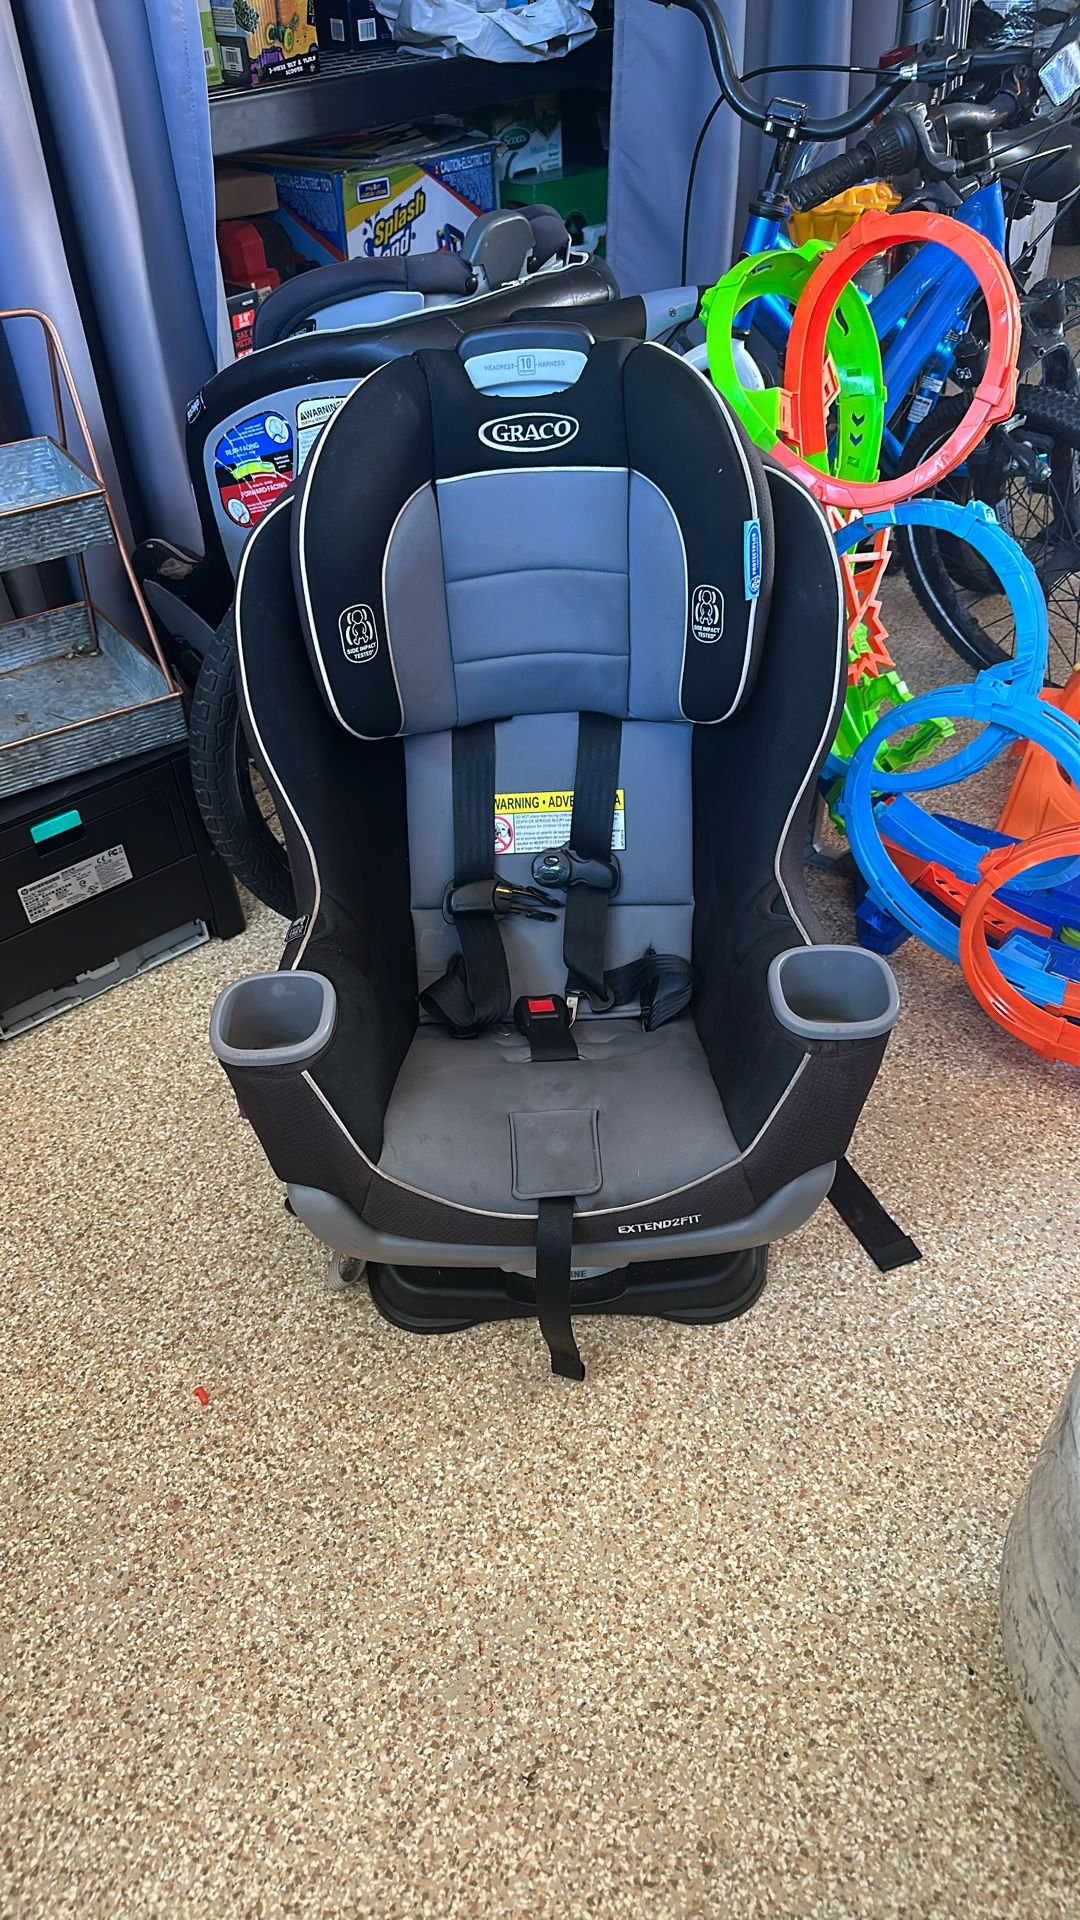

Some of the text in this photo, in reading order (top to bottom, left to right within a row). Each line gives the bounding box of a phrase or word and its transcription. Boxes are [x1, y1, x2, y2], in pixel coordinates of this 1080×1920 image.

[375, 191, 425, 247] Splash
[485, 363, 514, 371] HEADREST
[520, 358, 532, 369] 10
[492, 420, 571, 442] GRACO
[241, 481, 288, 498] FORWARD-FACING
[346, 642, 376, 655] SIDE IMPACT
[618, 1214, 701, 1234] EXTEND2FIT
